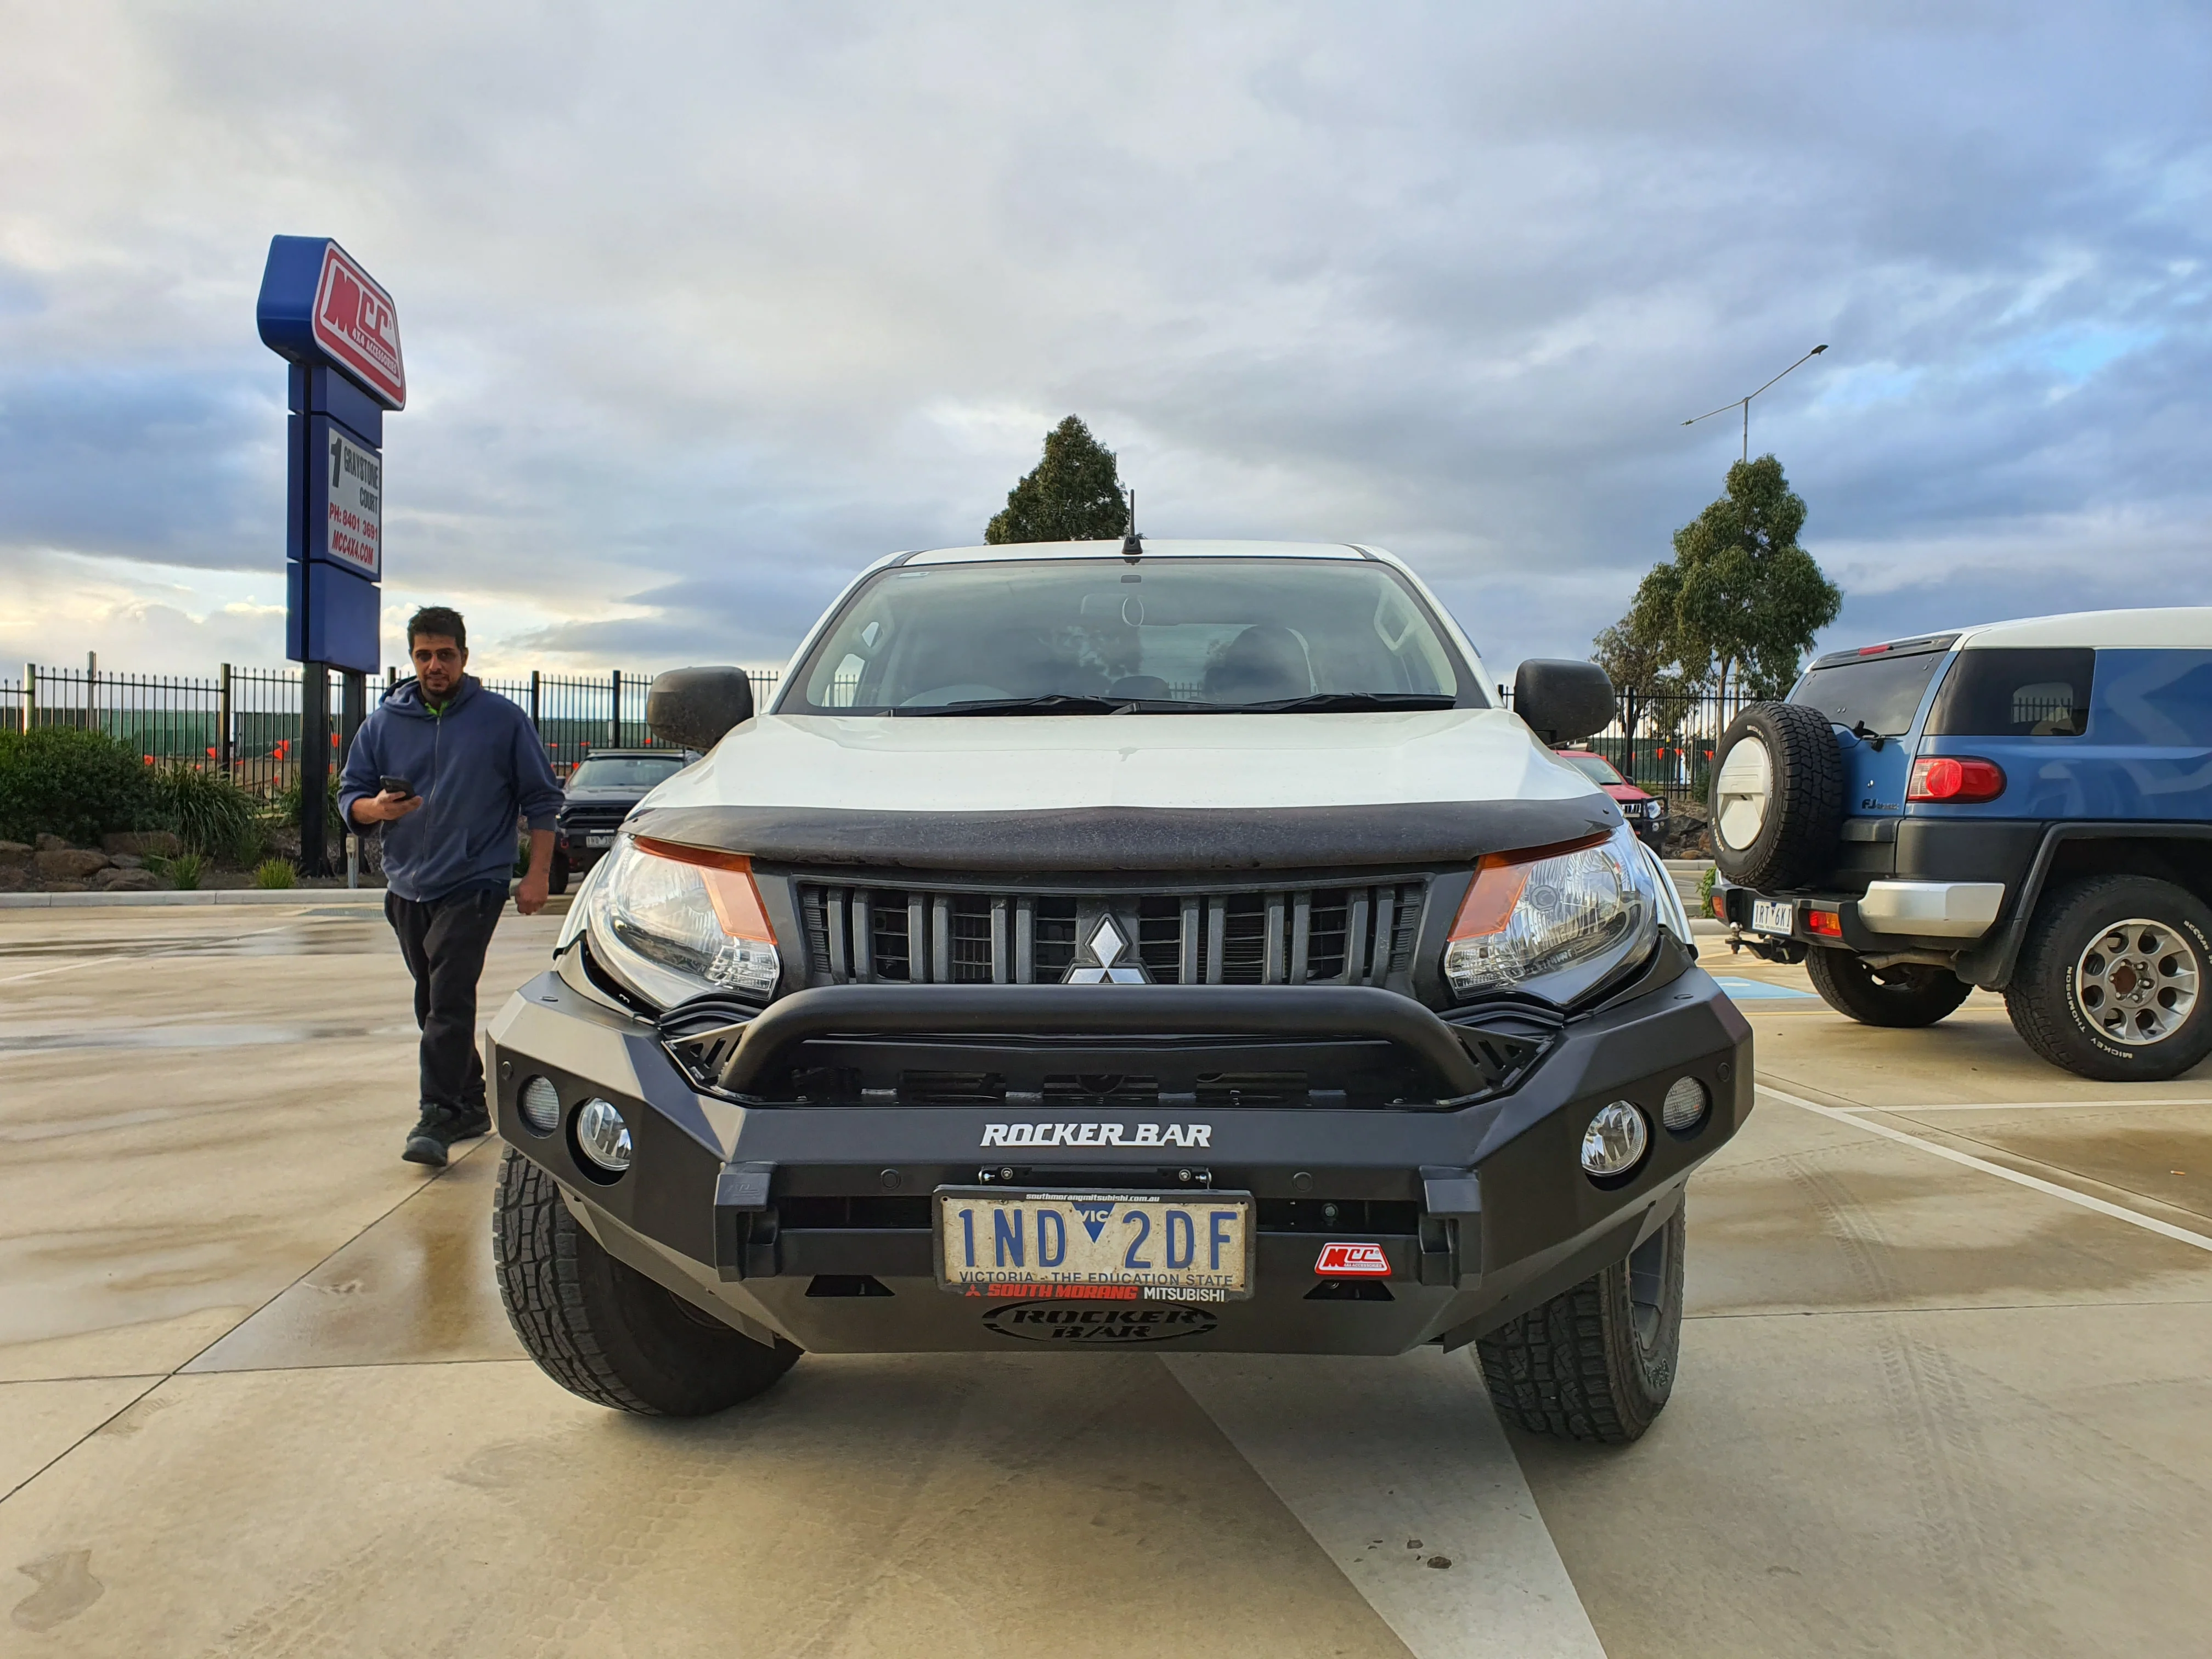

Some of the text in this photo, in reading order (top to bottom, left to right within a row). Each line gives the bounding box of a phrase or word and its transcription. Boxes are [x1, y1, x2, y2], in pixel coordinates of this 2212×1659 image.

[352, 328, 397, 375] 4X4 ACCESSORIES
[330, 437, 342, 488] 1
[344, 445, 378, 490] GRAYSTONE
[359, 487, 378, 514] COURT
[329, 502, 378, 541] PH: 8401 3691
[332, 529, 374, 565] MCC4X4.COM
[2066, 966, 2133, 1059] MICKEY THOMPSON
[980, 1123, 1212, 1147] ROCKER BAR
[1026, 1193, 1160, 1202] southmorangmitsubishi.com.au
[958, 1208, 1238, 1270] 1ND VIC 2DF
[959, 1271, 1034, 1282] VICTORIA
[1051, 1272, 1082, 1283] THE
[1088, 1273, 1179, 1285] EDUCATION
[1186, 1274, 1233, 1286] STATE
[988, 1284, 1225, 1302] SOUTH MORANG MITSUBISHI
[1012, 1310, 1197, 1324] ROCKER
[1051, 1325, 1151, 1338] BAR
